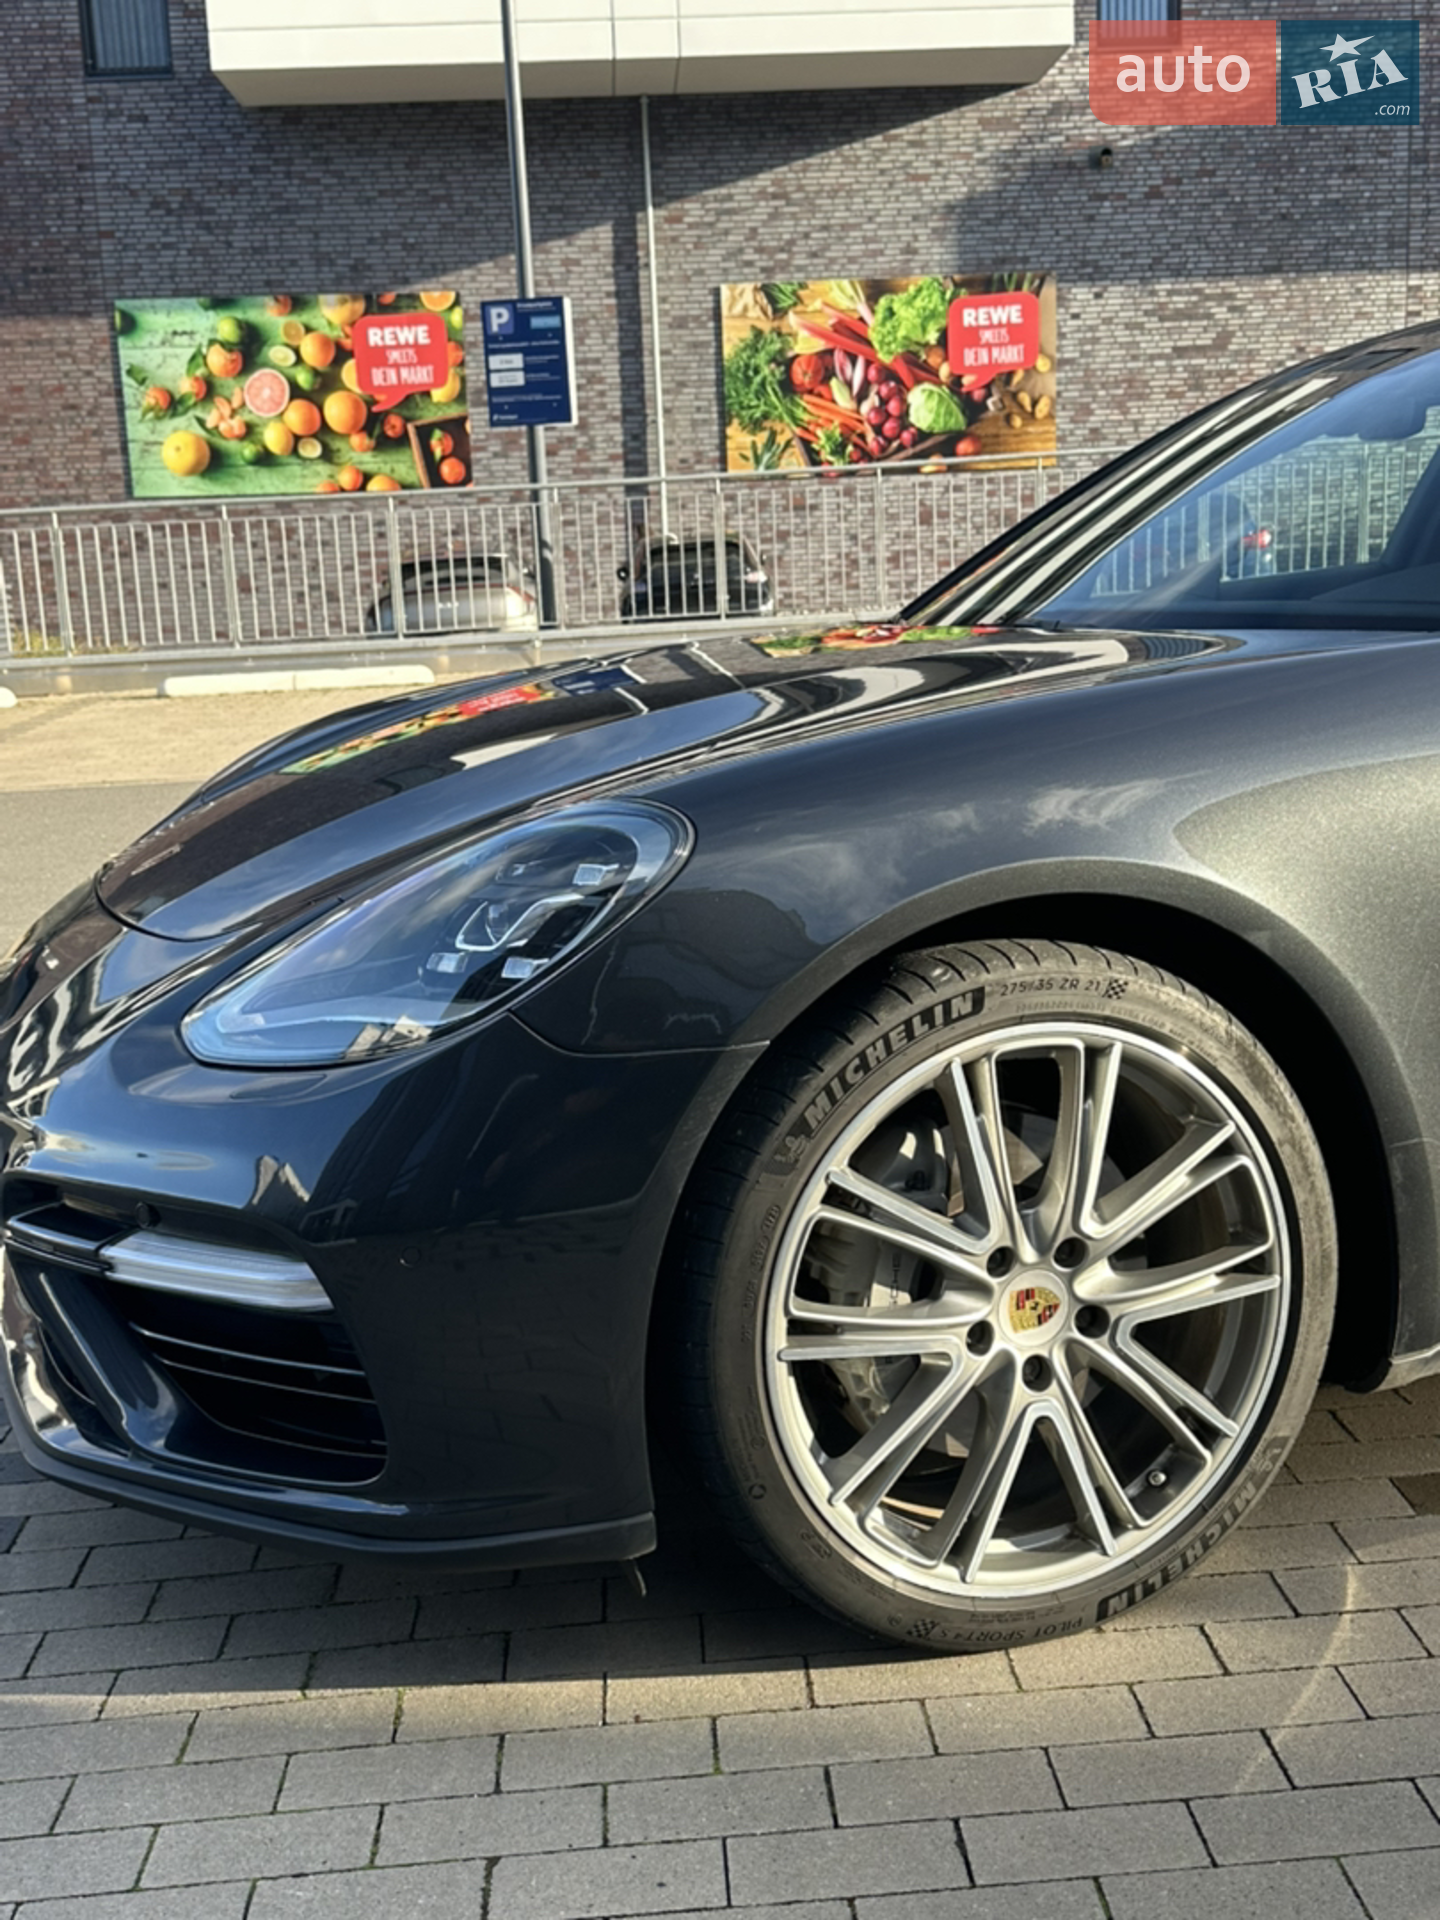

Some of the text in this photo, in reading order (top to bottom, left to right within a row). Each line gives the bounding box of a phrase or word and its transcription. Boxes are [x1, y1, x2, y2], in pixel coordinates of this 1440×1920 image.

[490, 306, 510, 333] P
[962, 304, 1024, 328] REWE
[367, 324, 431, 347] REWE
[963, 343, 1024, 367] DEIN MARKT
[371, 364, 434, 387] DEIN MARKT
[1000, 977, 1100, 997] 275/35 ZR 21
[804, 991, 974, 1130] MICHELIN
[1107, 1480, 1257, 1615] MICHELIN
[1033, 1617, 1084, 1638] PILOT
